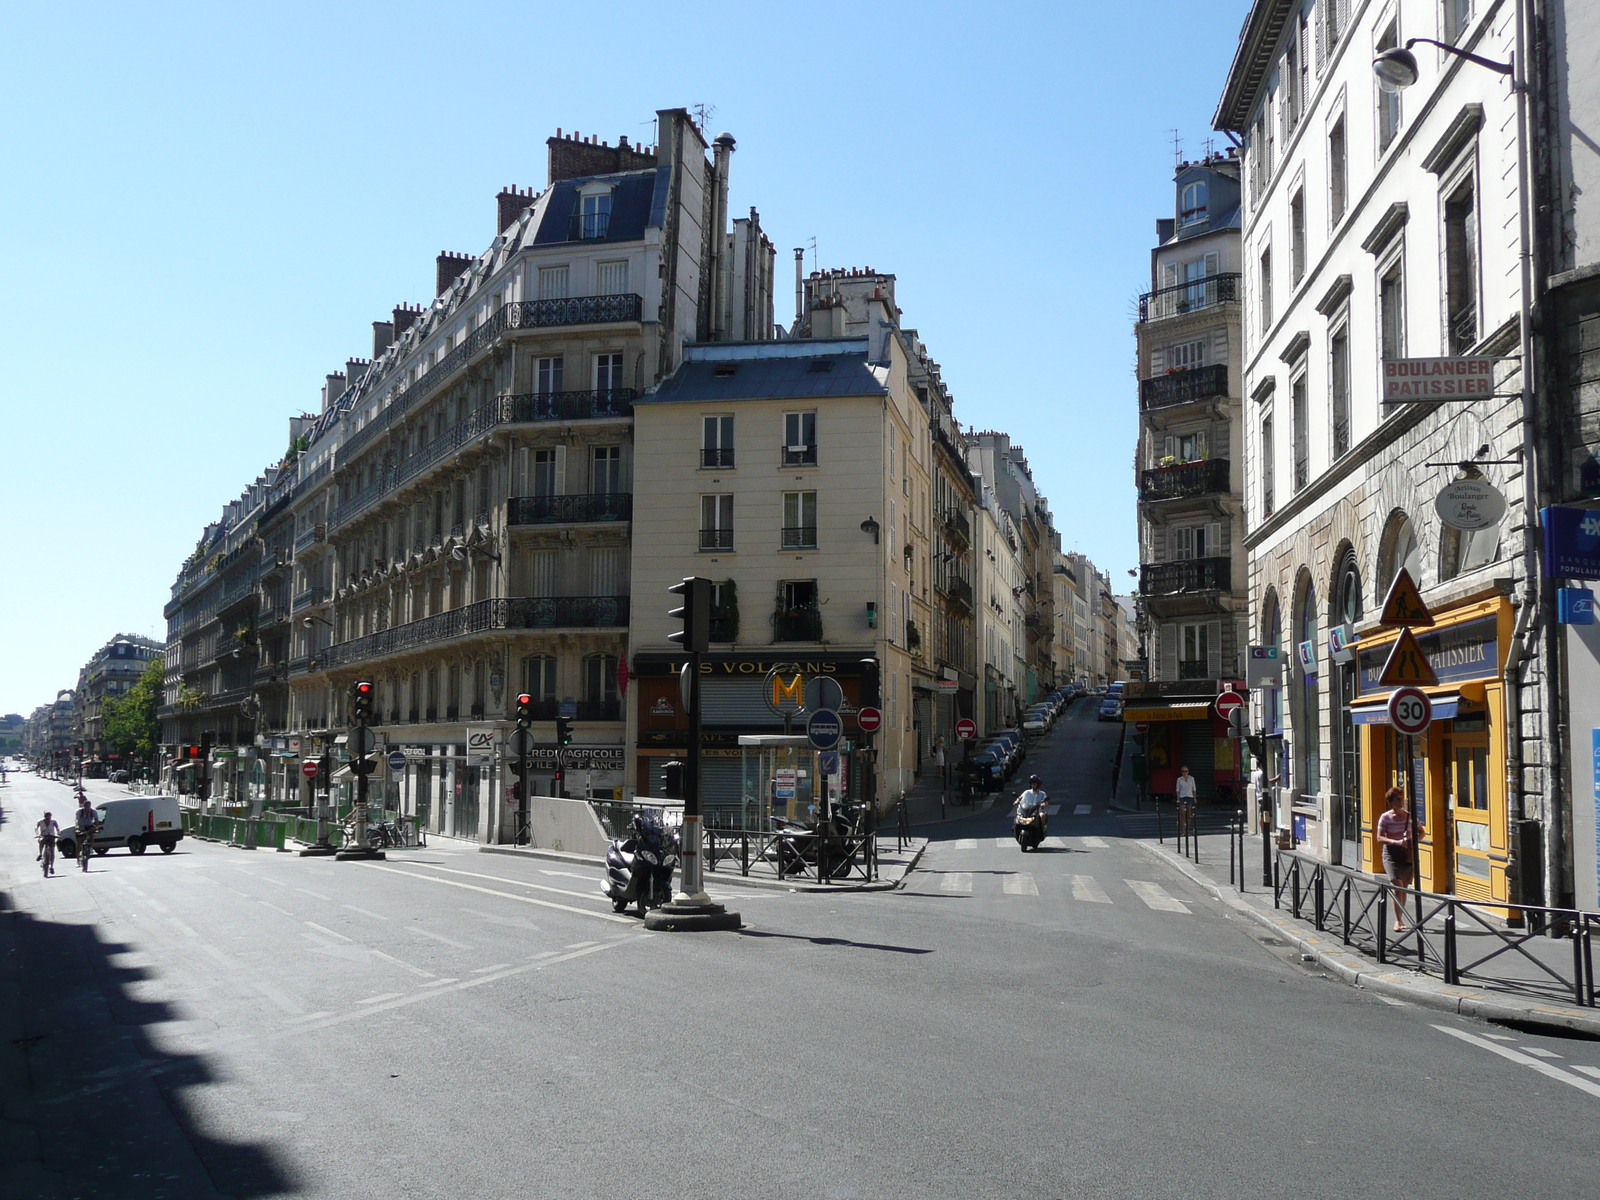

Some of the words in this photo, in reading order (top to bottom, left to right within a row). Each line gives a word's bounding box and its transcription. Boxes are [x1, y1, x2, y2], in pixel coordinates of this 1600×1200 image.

[1385, 360, 1490, 378] BOULANGER
[1388, 378, 1489, 396] PATISSIER
[1447, 492, 1489, 501] Boulanger
[1455, 484, 1481, 492] Artisan
[1429, 636, 1485, 669] PATISSIER
[669, 662, 713, 674] LS
[773, 673, 803, 707] M
[1400, 701, 1423, 720] 30
[567, 749, 623, 758] AGRICOLE
